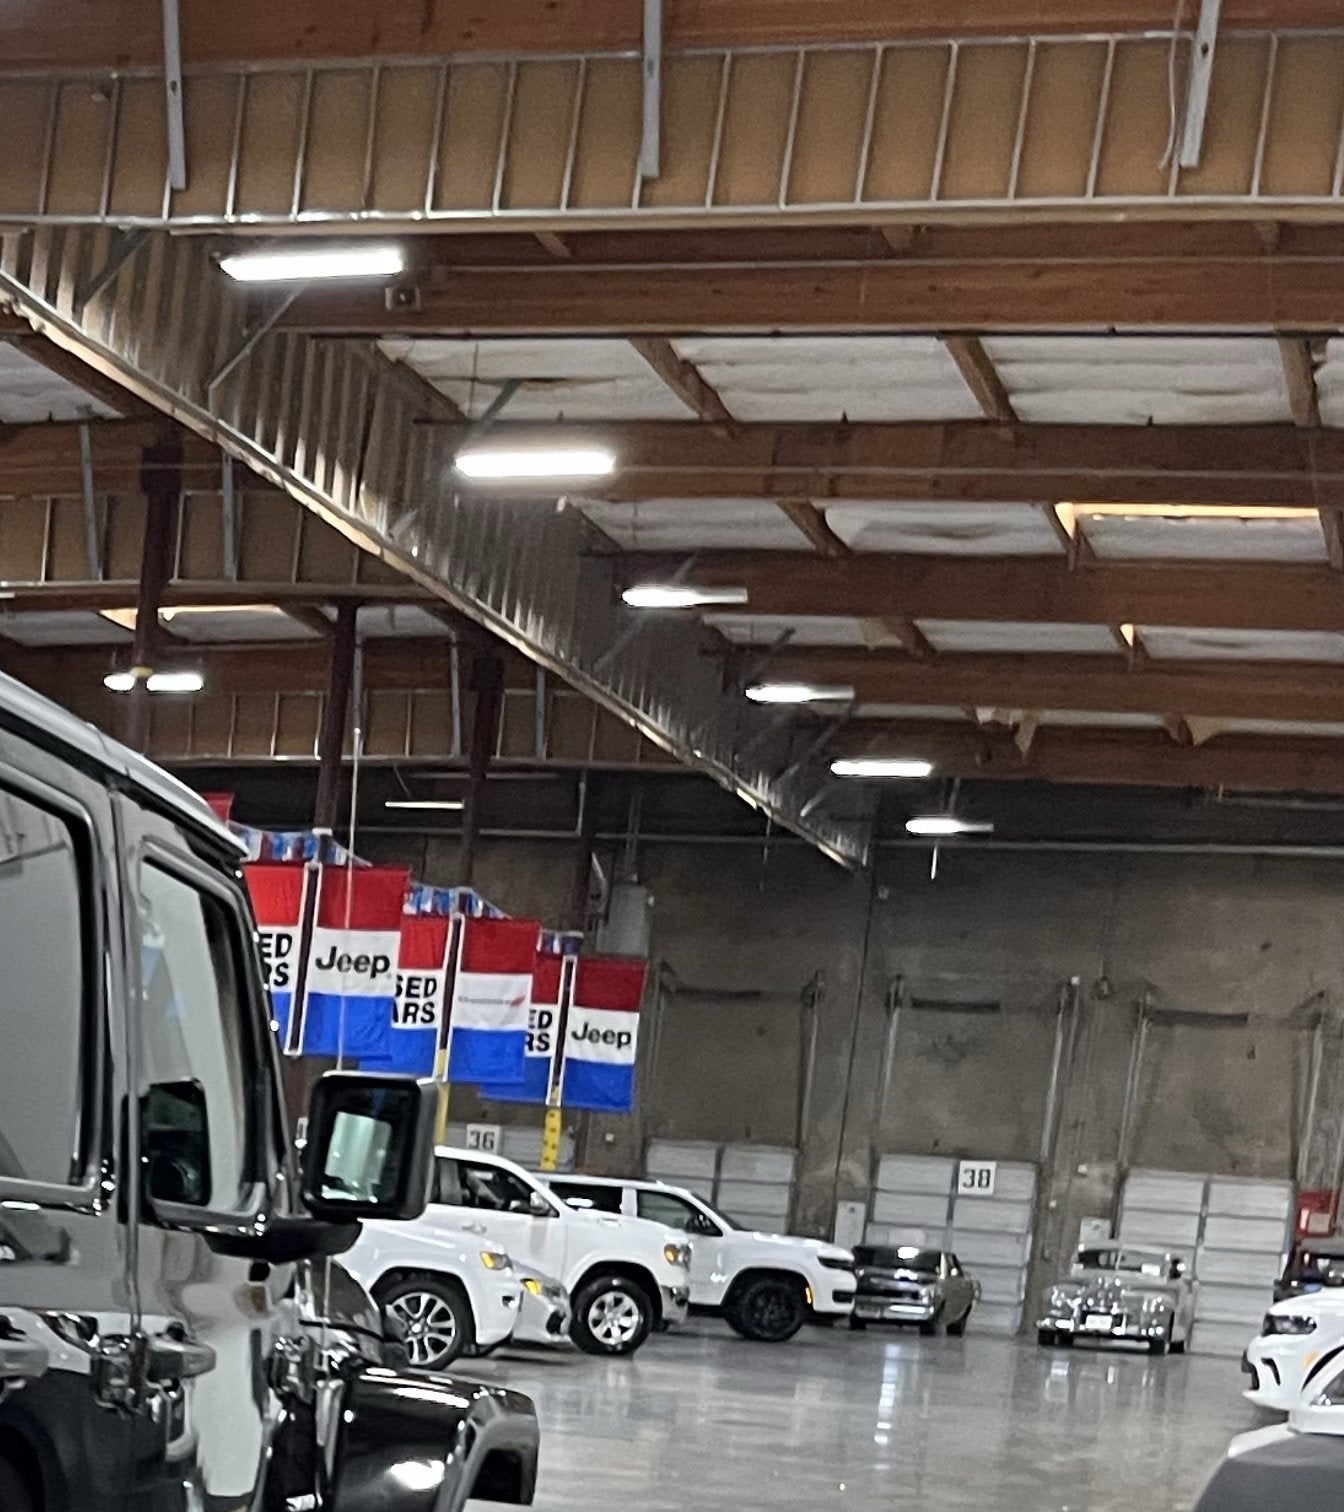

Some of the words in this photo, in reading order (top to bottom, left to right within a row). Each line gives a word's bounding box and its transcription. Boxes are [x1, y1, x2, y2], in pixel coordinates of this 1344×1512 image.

[315, 946, 391, 979] Jeep
[572, 1021, 631, 1049] Jeep
[469, 1130, 495, 1150] 36
